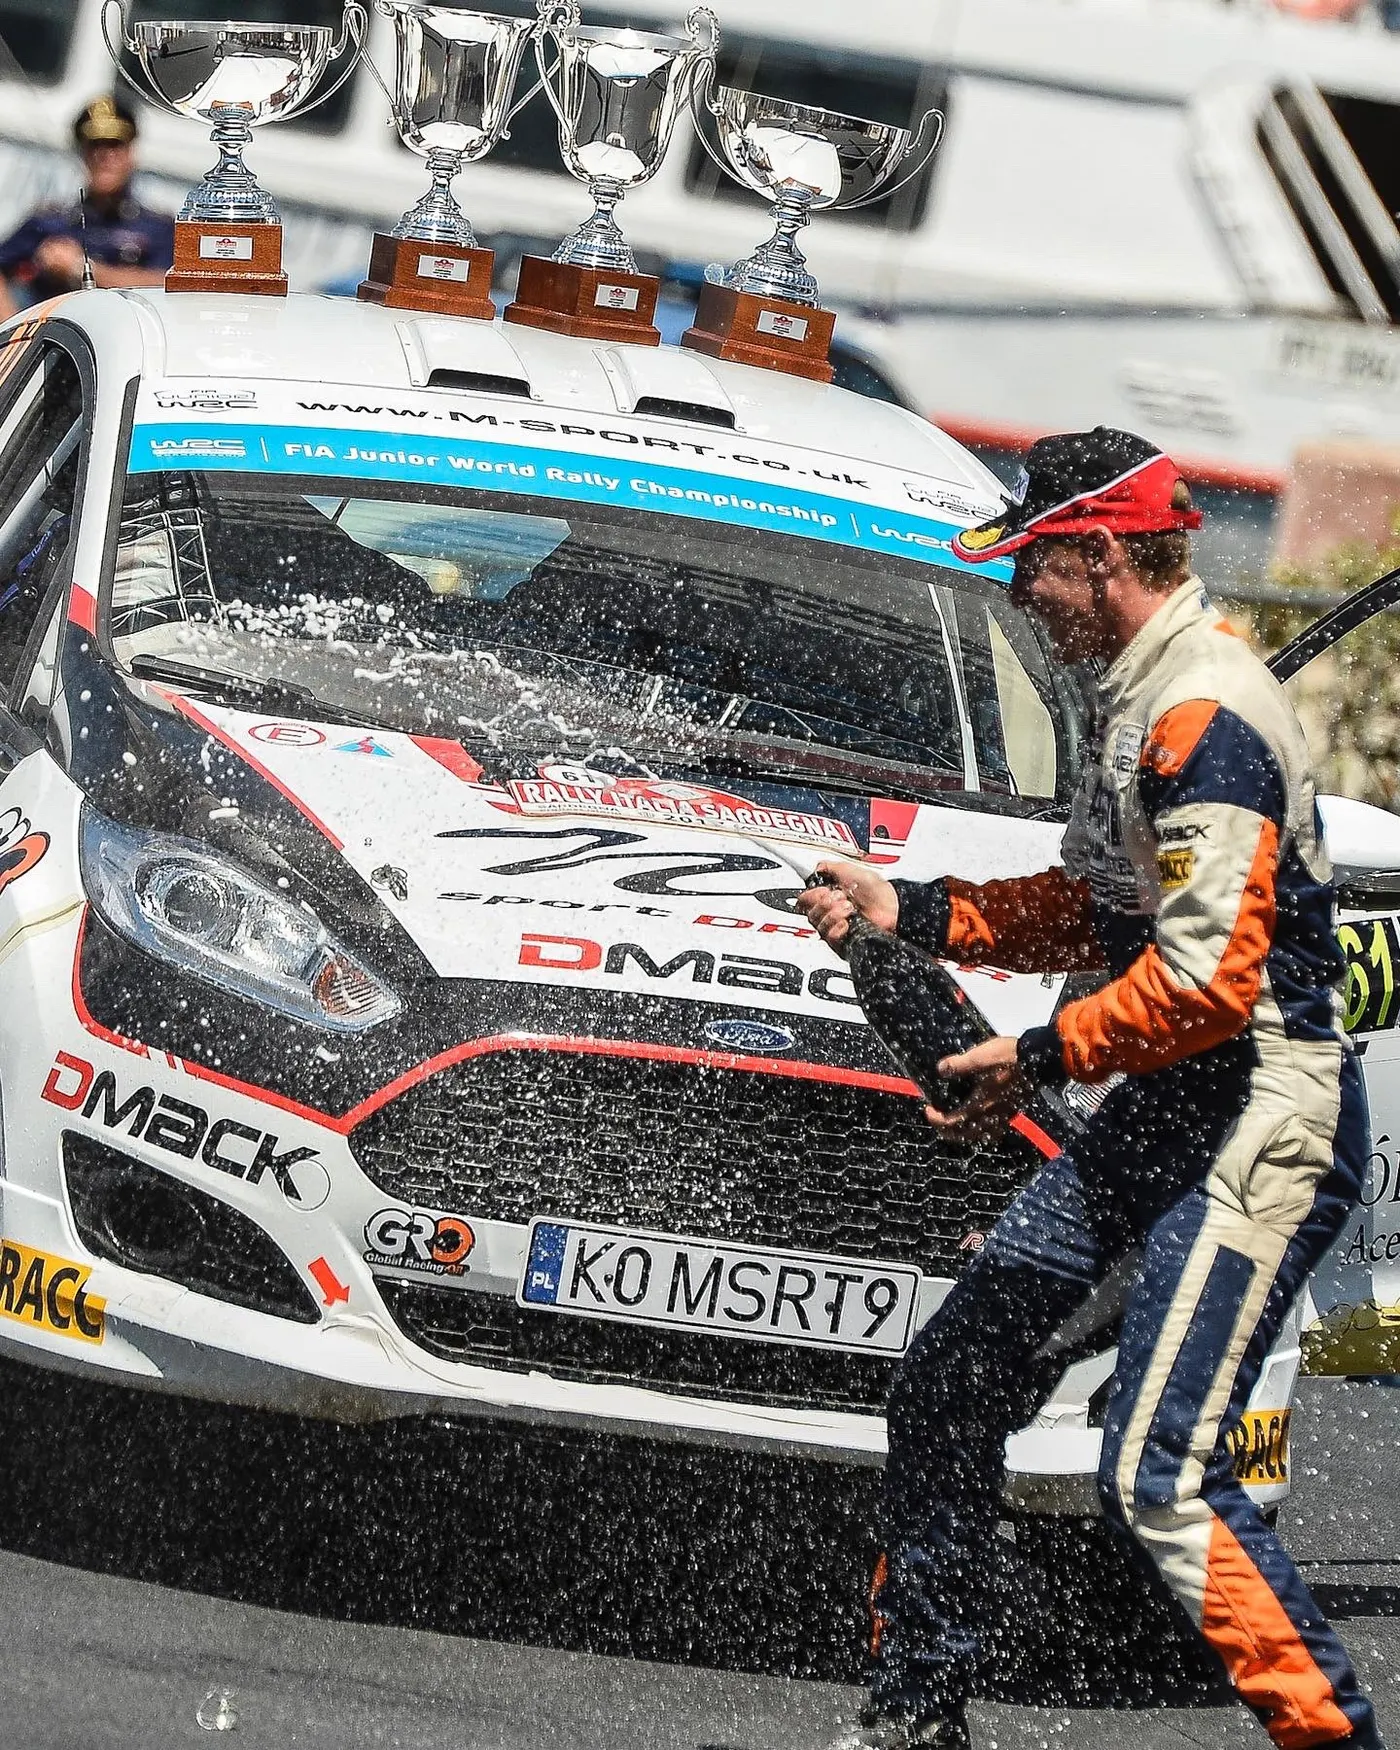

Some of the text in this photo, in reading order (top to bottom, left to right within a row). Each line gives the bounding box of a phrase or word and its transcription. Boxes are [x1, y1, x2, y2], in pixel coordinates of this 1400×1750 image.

[151, 438, 245, 450] WRC
[156, 400, 259, 409] WRC
[296, 401, 871, 490] www.M-SPORT.co.uk
[284, 442, 839, 528] FIA Junior World Rally Championship
[521, 783, 603, 805] RALLY
[700, 801, 845, 843] SARDEGNA
[1336, 920, 1394, 1032] 61
[0, 1245, 102, 1339] RACC
[531, 1271, 556, 1290] PL
[666, 1250, 901, 1340] MSRT9
